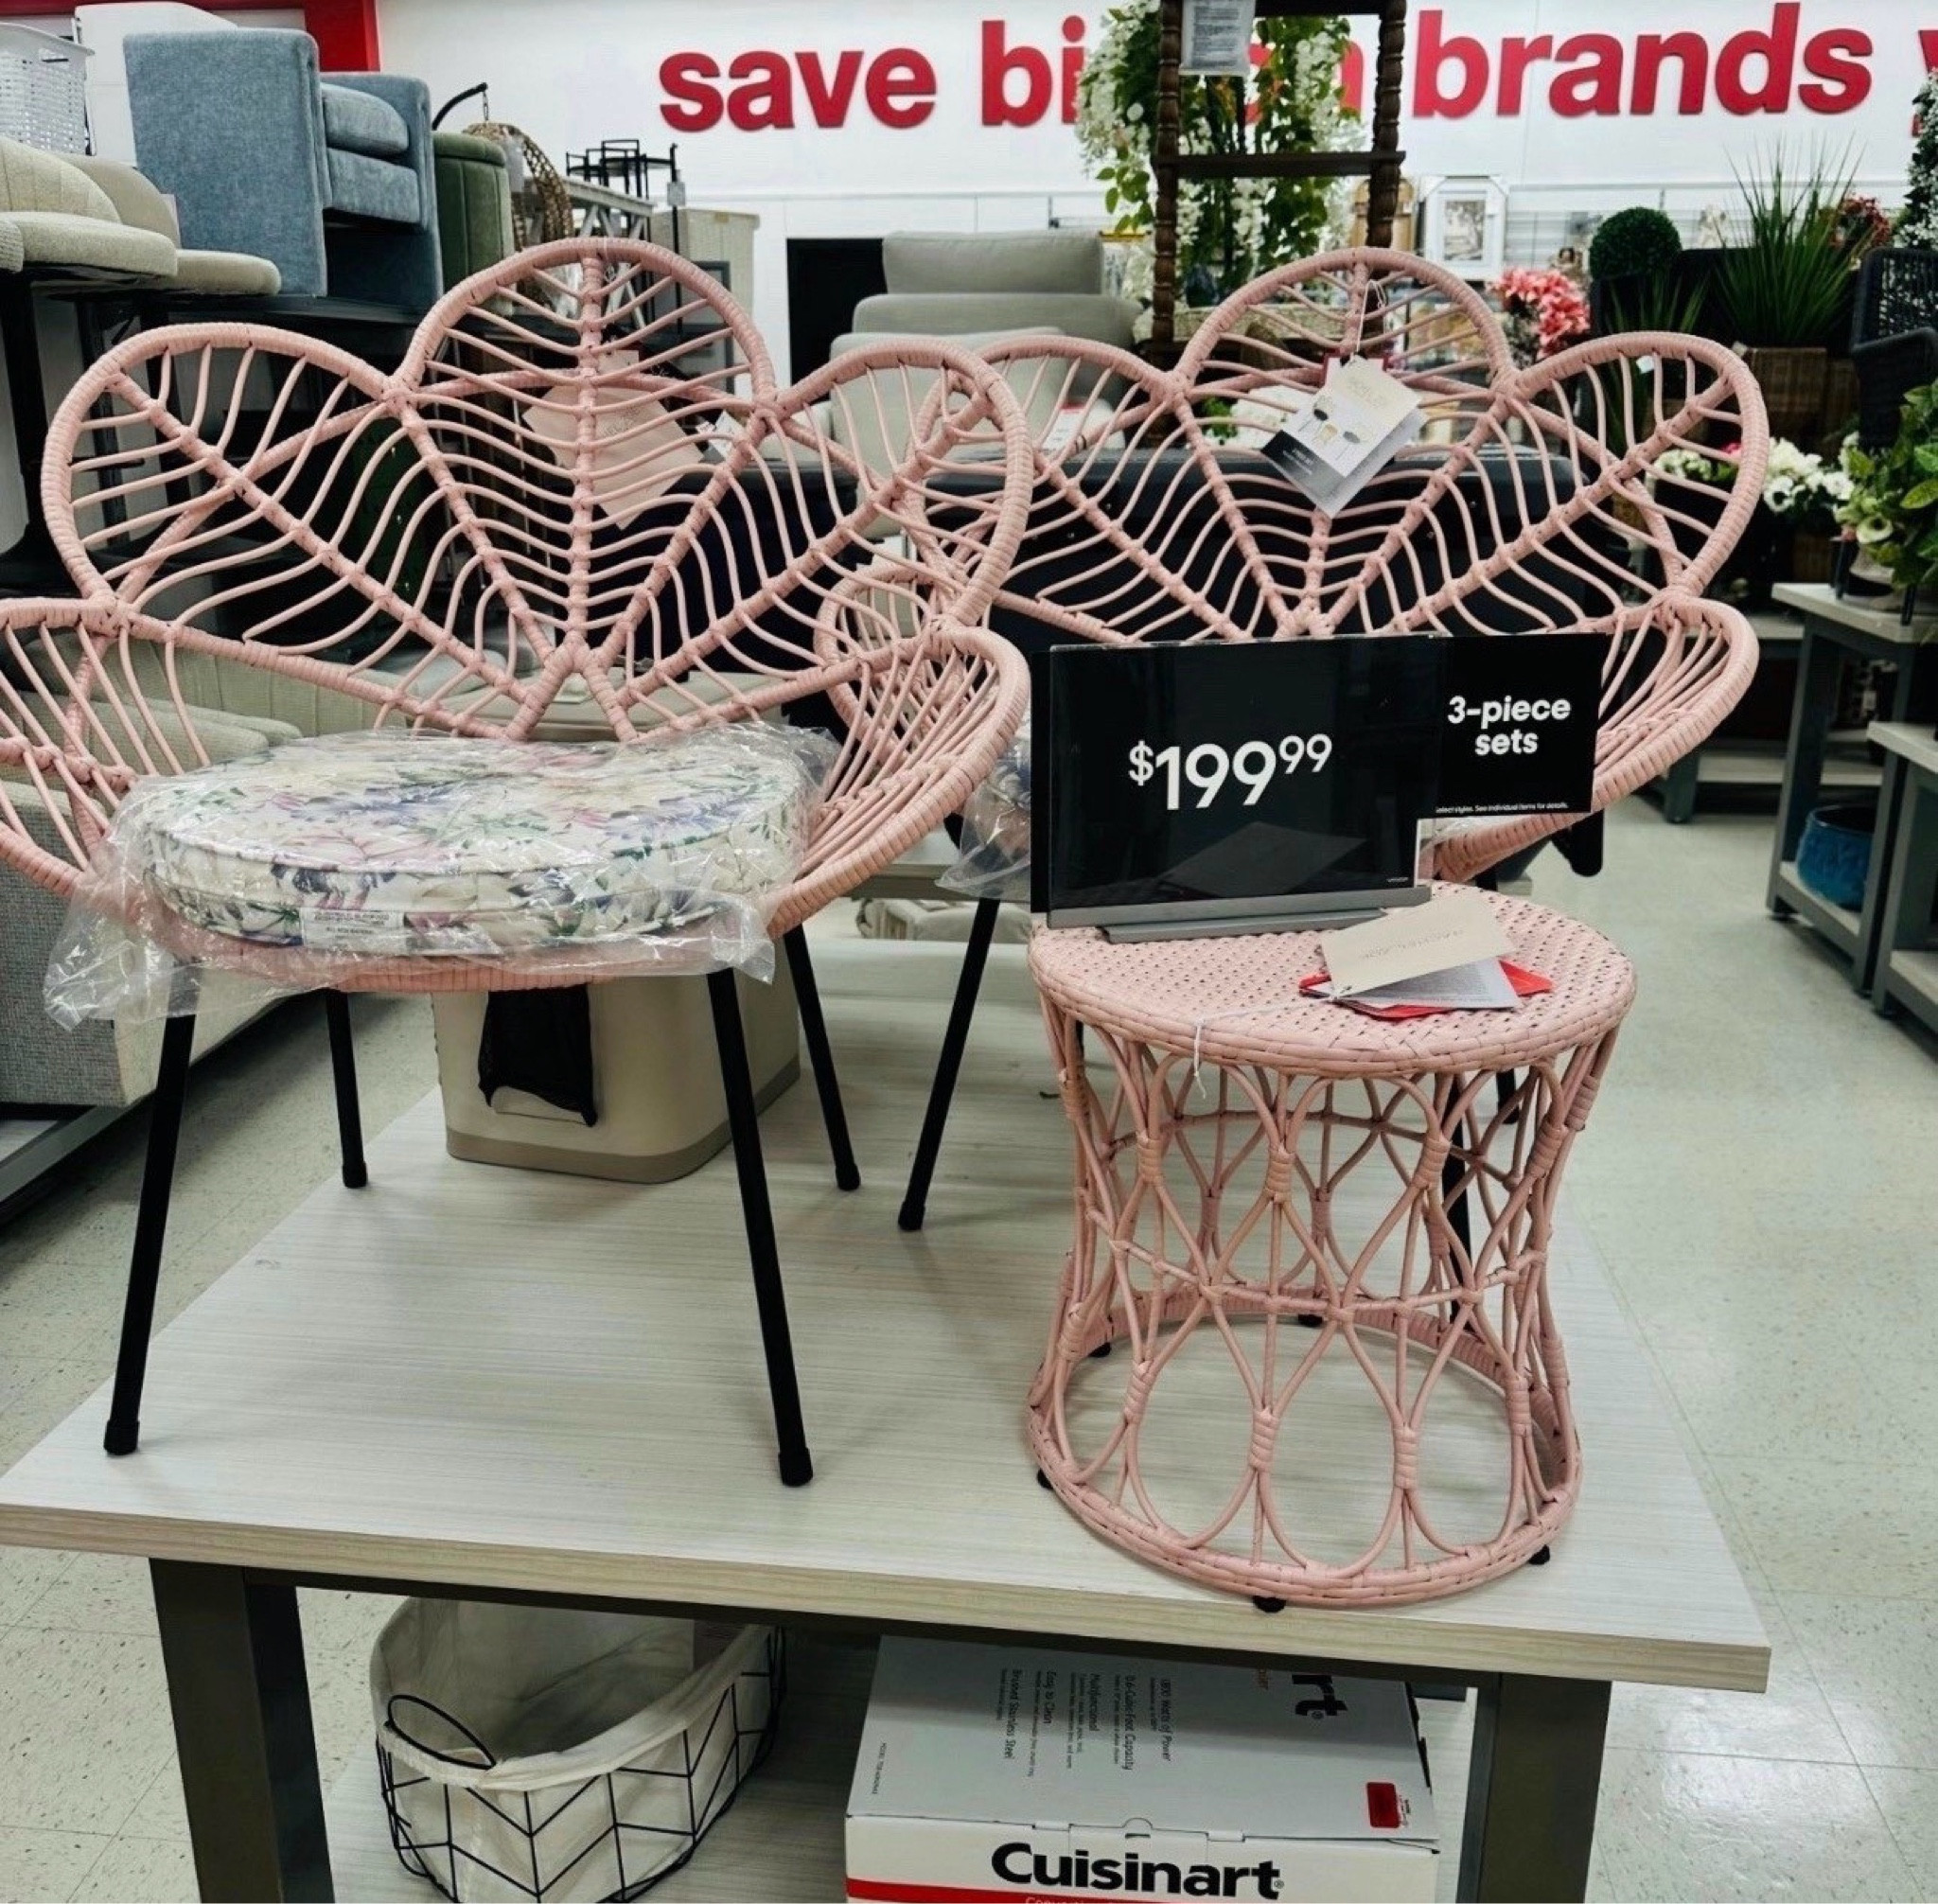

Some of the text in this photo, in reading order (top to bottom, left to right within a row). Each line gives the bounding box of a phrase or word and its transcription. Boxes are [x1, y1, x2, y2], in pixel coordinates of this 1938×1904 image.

[660, 48, 937, 132] save
[981, 15, 1088, 129] bi
[1412, 2, 1873, 118] brands
[1447, 695, 1572, 730] 3-piece
[1474, 729, 1539, 755] sets
[1004, 1739, 1016, 1760] Steel
[1121, 1734, 1136, 1771] Capacity
[1162, 1736, 1172, 1762] Power
